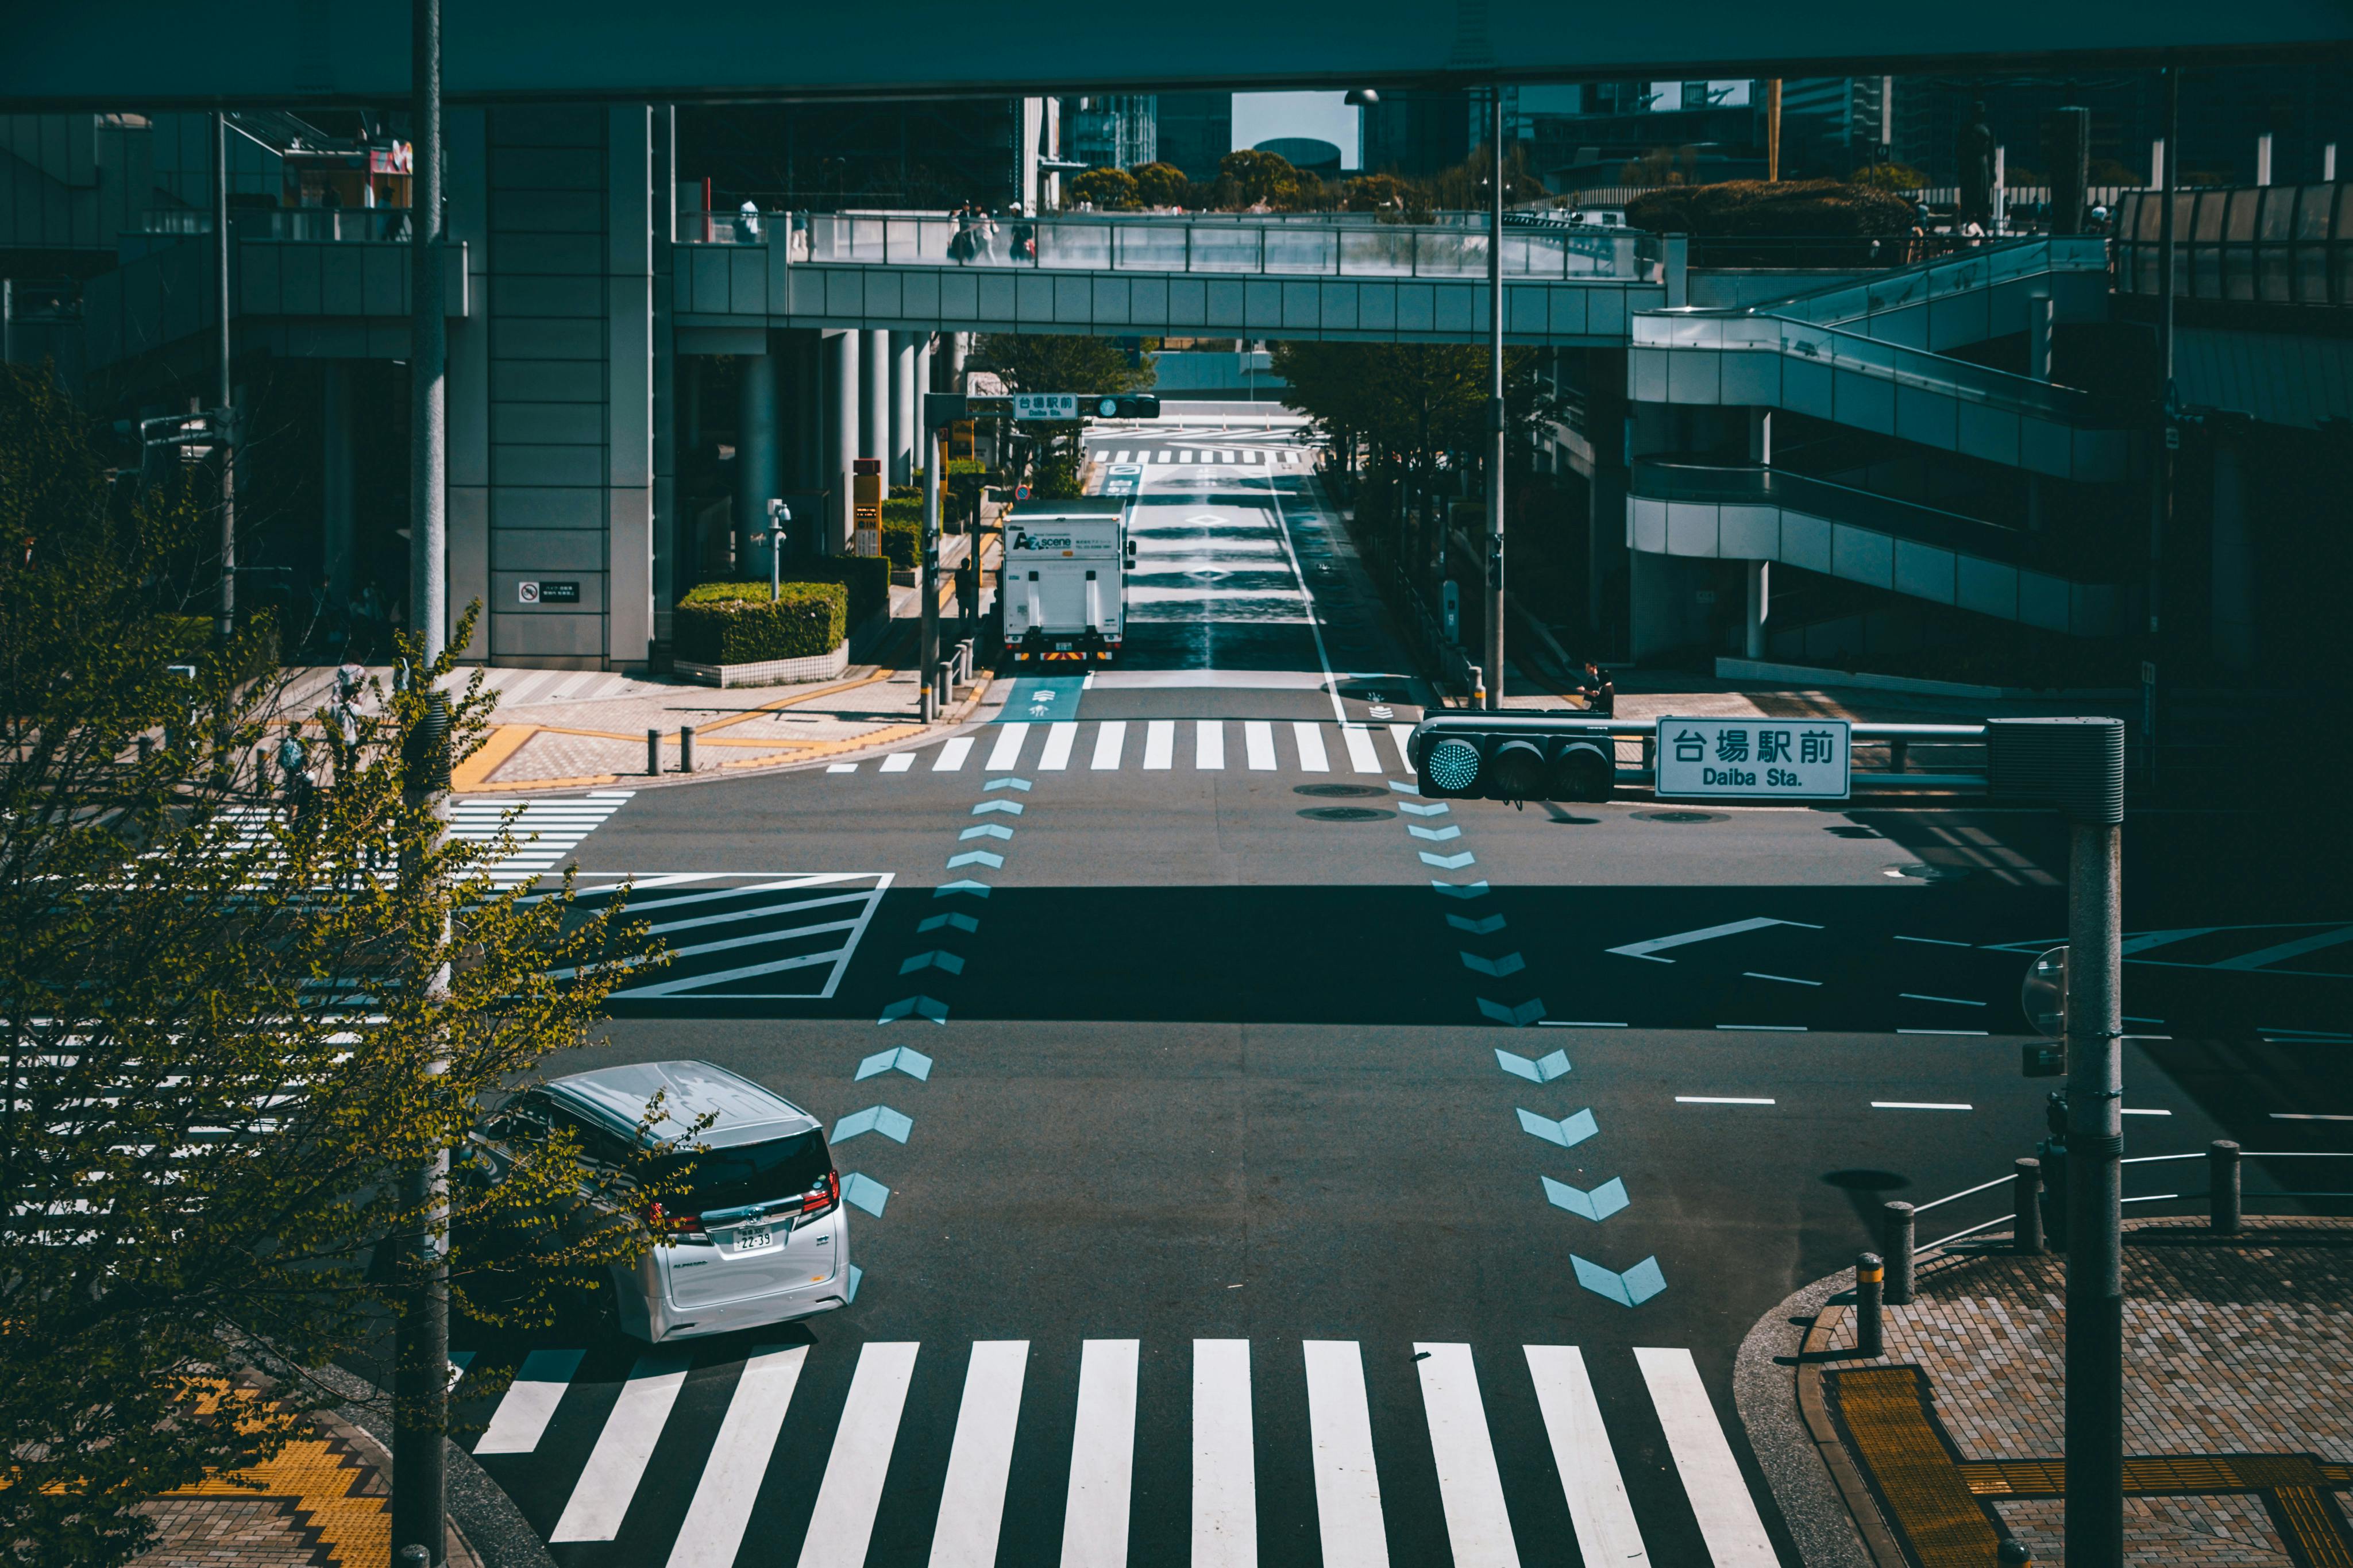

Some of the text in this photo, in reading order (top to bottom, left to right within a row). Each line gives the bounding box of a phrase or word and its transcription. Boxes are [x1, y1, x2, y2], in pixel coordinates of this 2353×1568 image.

[1019, 397, 1072, 408] 台場駅前
[1042, 538, 1071, 546] scene
[1673, 729, 1834, 764] 台場駅前
[1703, 767, 1803, 787] Daiba Sta.
[742, 1233, 770, 1249] 22-39
